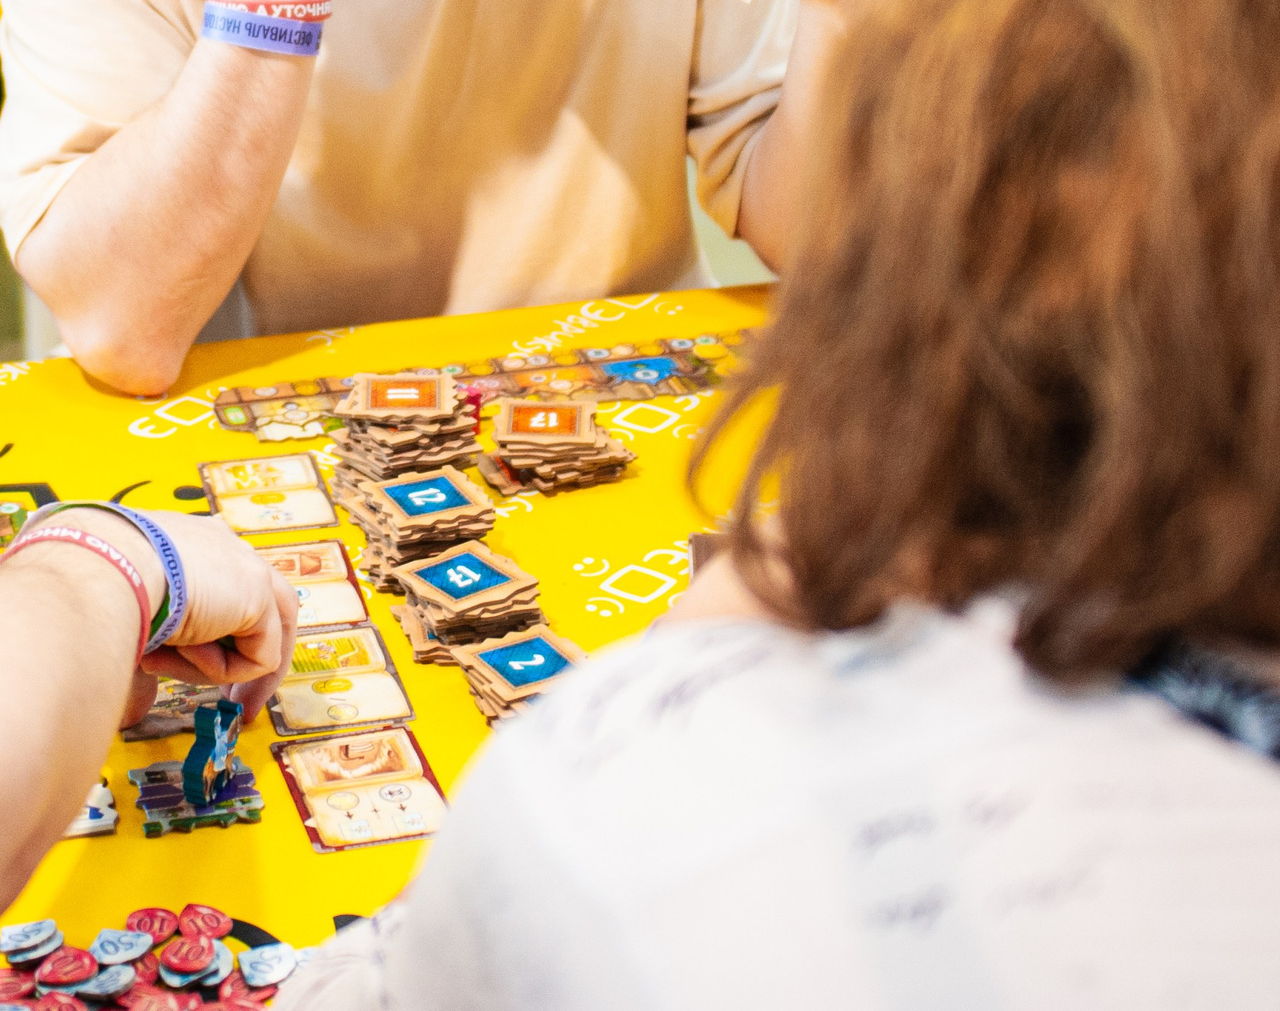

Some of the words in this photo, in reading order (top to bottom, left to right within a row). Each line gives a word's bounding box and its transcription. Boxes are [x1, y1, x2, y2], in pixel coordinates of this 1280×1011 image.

[244, 21, 313, 47] ФЕСТИВАЛЬ
[385, 387, 421, 400] 11
[528, 411, 560, 428] 17
[407, 487, 447, 506] 12
[446, 565, 482, 588] 17
[507, 653, 546, 671] 2
[136, 916, 169, 934] 10
[187, 912, 222, 936] 10
[98, 932, 135, 957] 50
[172, 941, 206, 962] 10
[249, 950, 283, 976] 50
